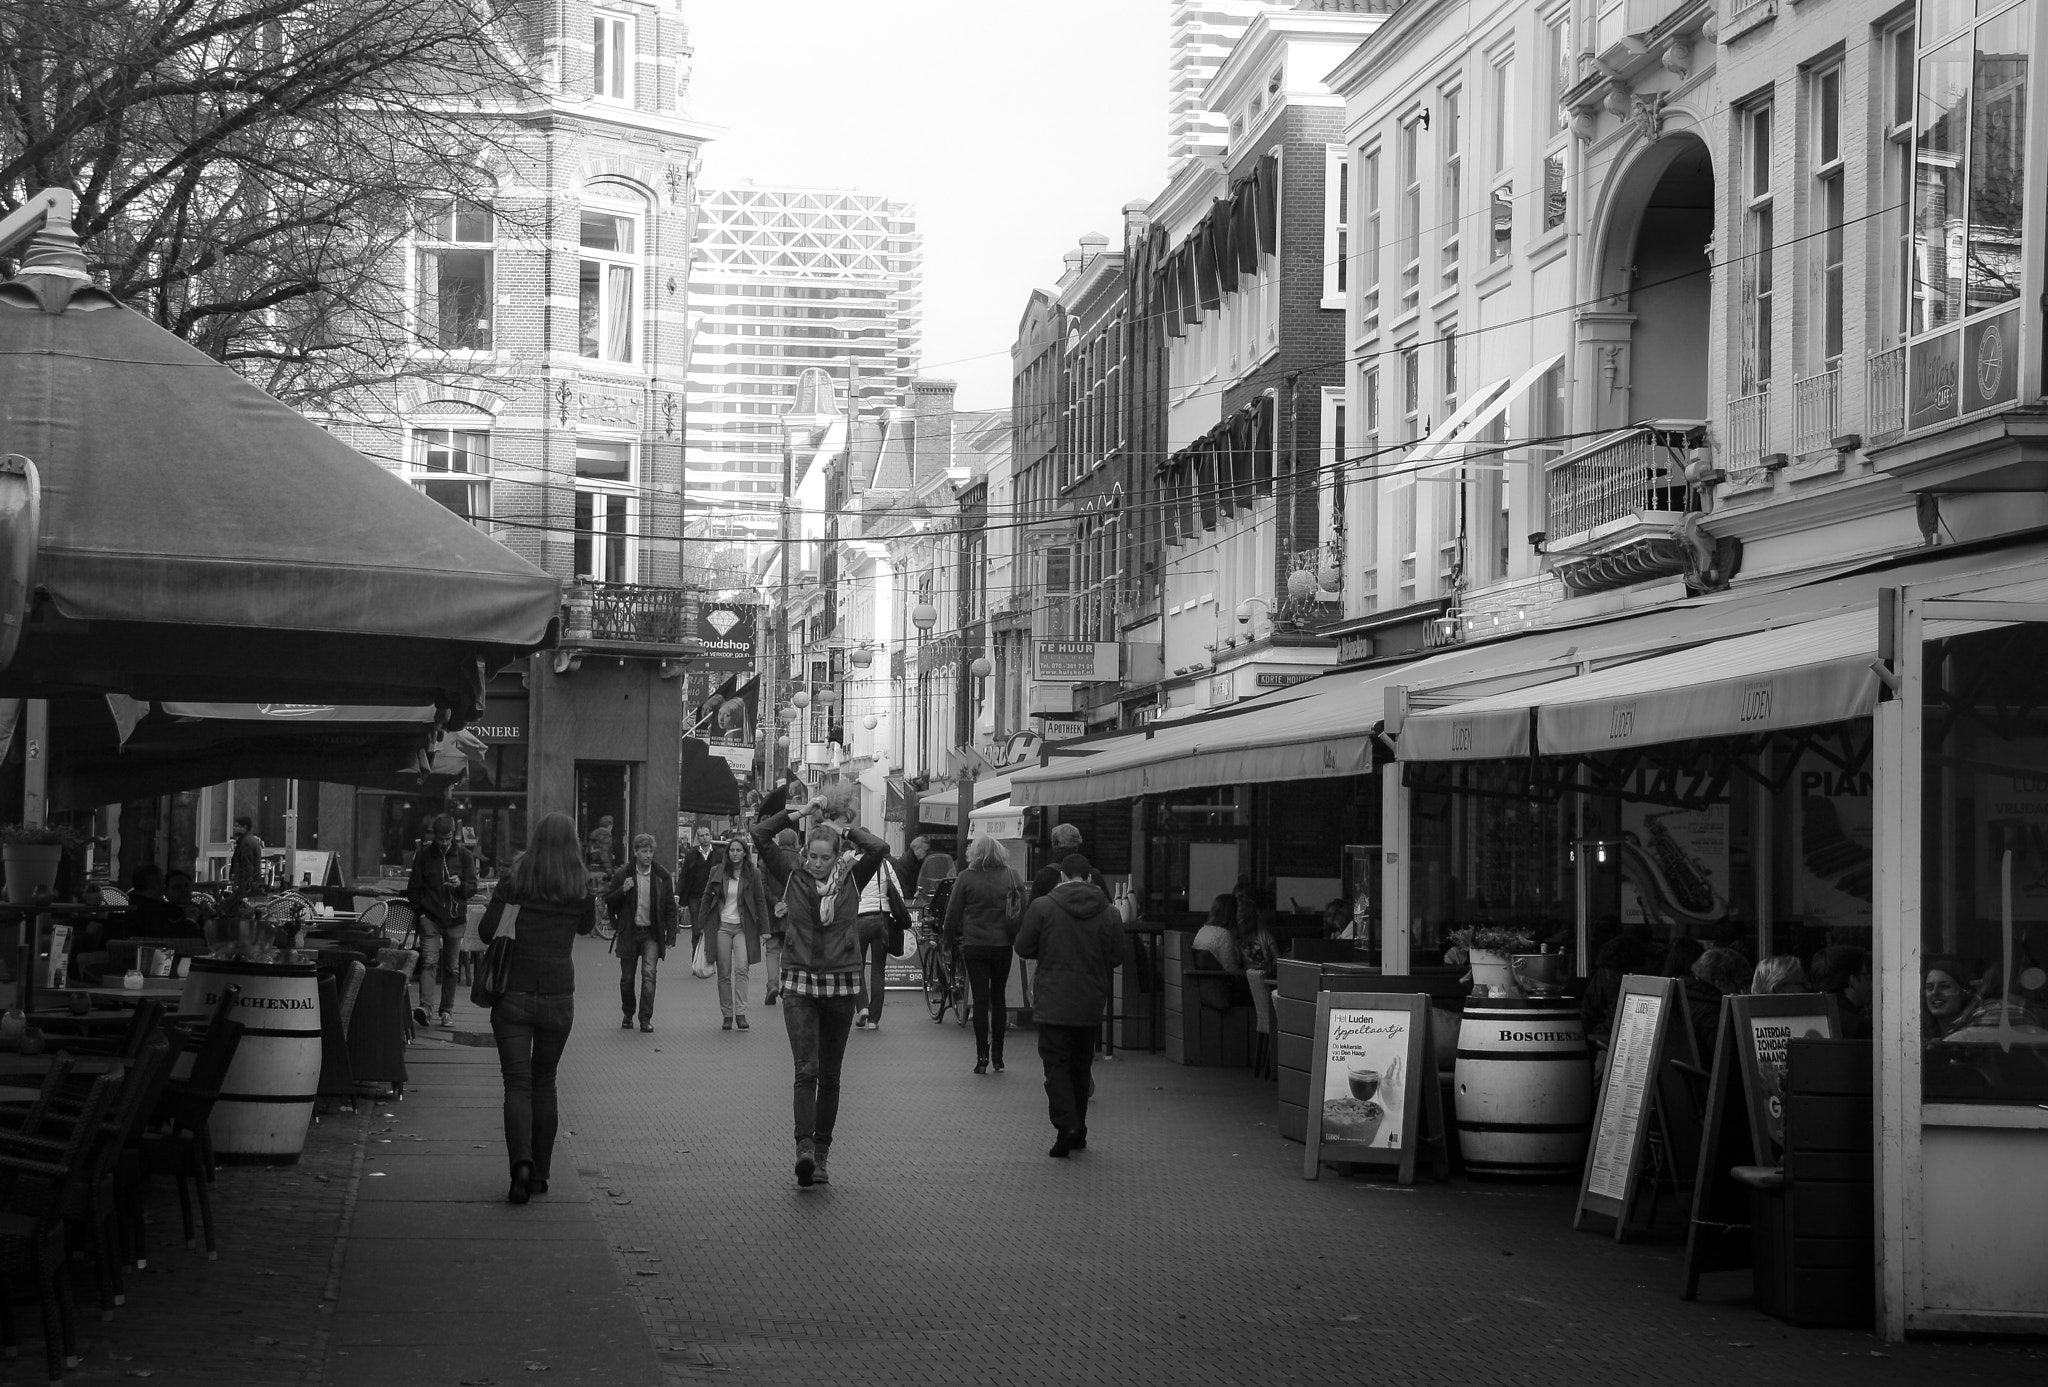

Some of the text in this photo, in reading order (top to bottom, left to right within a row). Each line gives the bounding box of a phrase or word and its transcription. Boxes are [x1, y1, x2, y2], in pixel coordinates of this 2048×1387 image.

[697, 639, 749, 651] Goudshop
[1059, 645, 1093, 653] HUUR
[1261, 675, 1283, 684] KORTE
[1740, 681, 1773, 721] LUDEN
[1610, 704, 1636, 739] LUDEN
[466, 726, 520, 737] ONIERE
[1048, 723, 1082, 734] APOTHEEK
[1452, 722, 1472, 751] LUDEN
[206, 993, 315, 1010] BSCHENDAL
[1334, 1015, 1374, 1024] Het Luden
[1333, 1024, 1405, 1041] Appeltaartje
[1755, 1027, 1791, 1039] ZATERDAG
[1757, 1040, 1787, 1051] ZONDAG
[1759, 1052, 1787, 1063] MAAND
